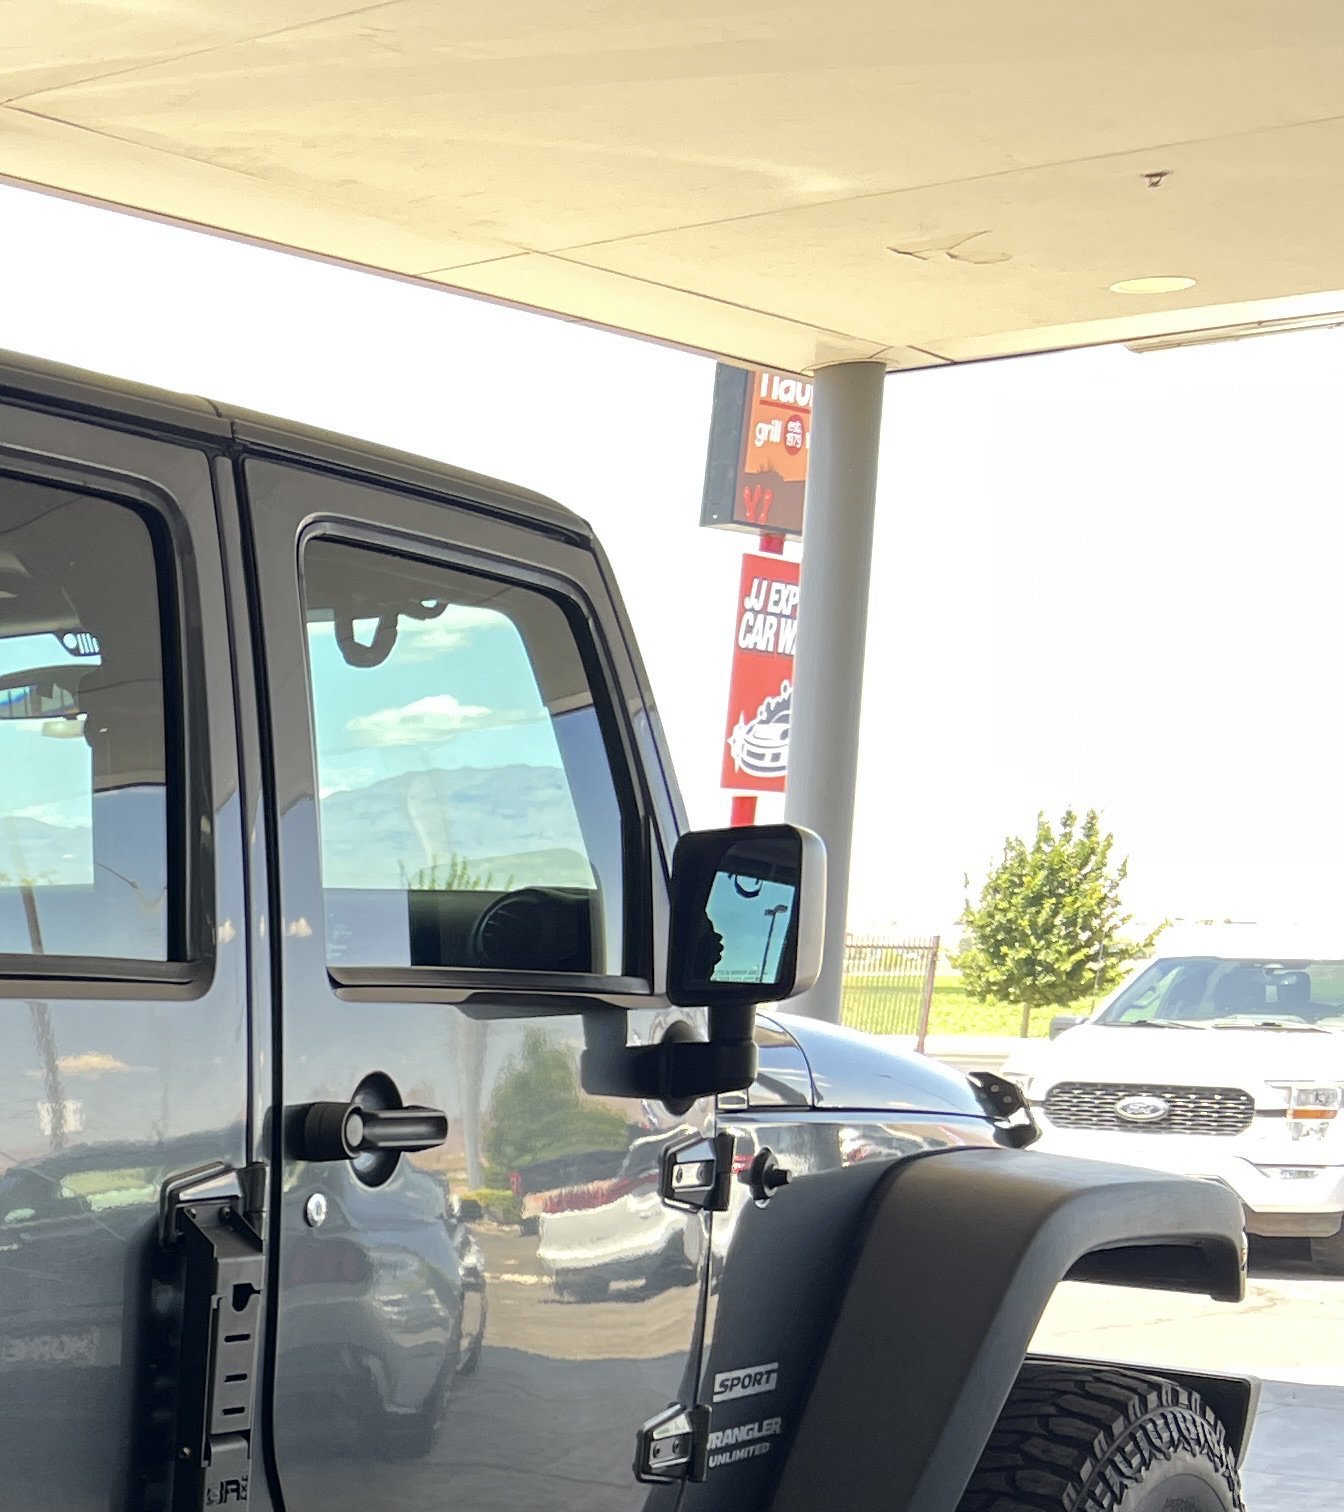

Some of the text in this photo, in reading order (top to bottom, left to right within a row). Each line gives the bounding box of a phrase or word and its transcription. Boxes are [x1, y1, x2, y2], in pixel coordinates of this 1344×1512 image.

[754, 419, 783, 448] grill
[743, 577, 800, 616] JJ EXP
[738, 610, 798, 656] CAR W
[714, 1367, 778, 1398] SPORT
[709, 1442, 771, 1468] UNLIMITED
